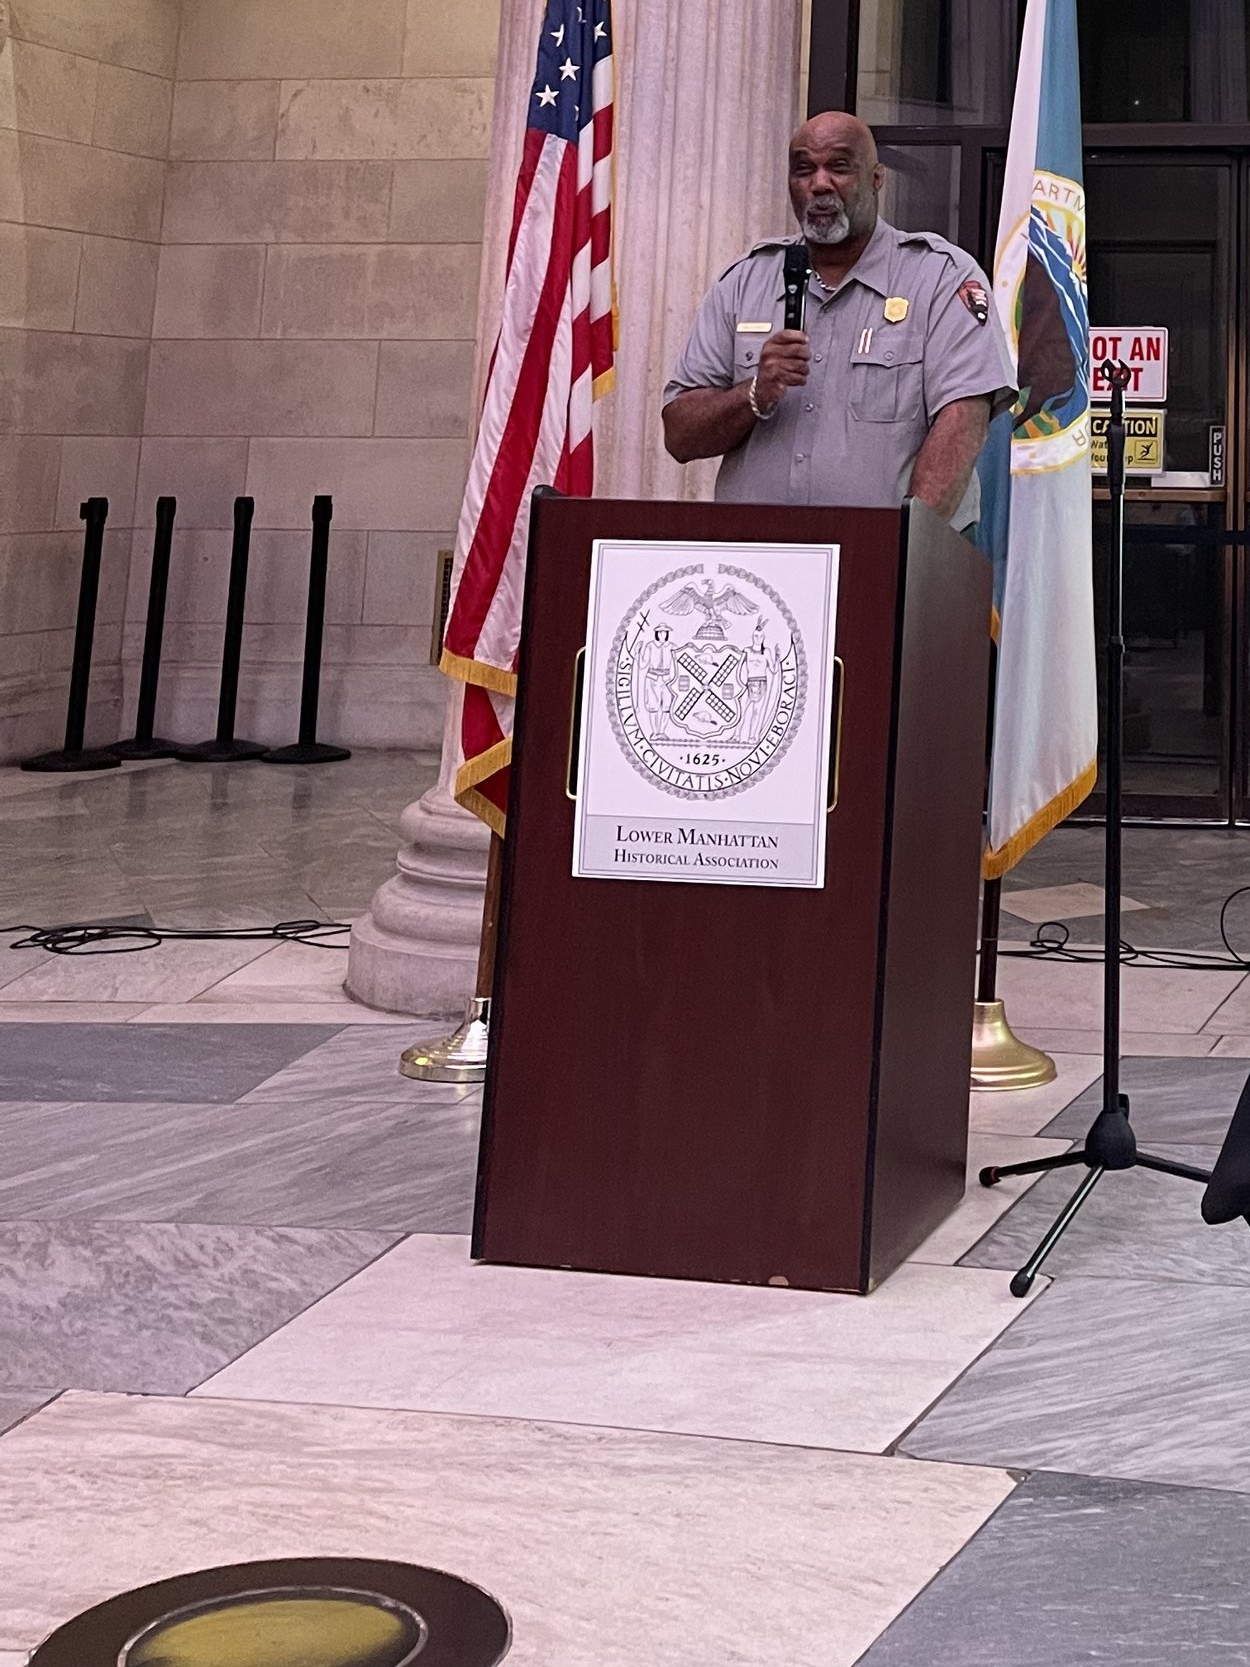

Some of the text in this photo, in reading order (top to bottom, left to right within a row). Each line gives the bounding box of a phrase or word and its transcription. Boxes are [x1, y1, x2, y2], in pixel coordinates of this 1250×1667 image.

[1092, 336, 1160, 361] OT AN
[1093, 367, 1143, 391] ET
[1093, 419, 1157, 435] CATION
[1213, 432, 1222, 481] PUSH
[642, 748, 724, 791] CIVITATIS
[726, 747, 769, 783] NOVI
[766, 667, 796, 747] EBORACI
[685, 752, 720, 767] 1625
